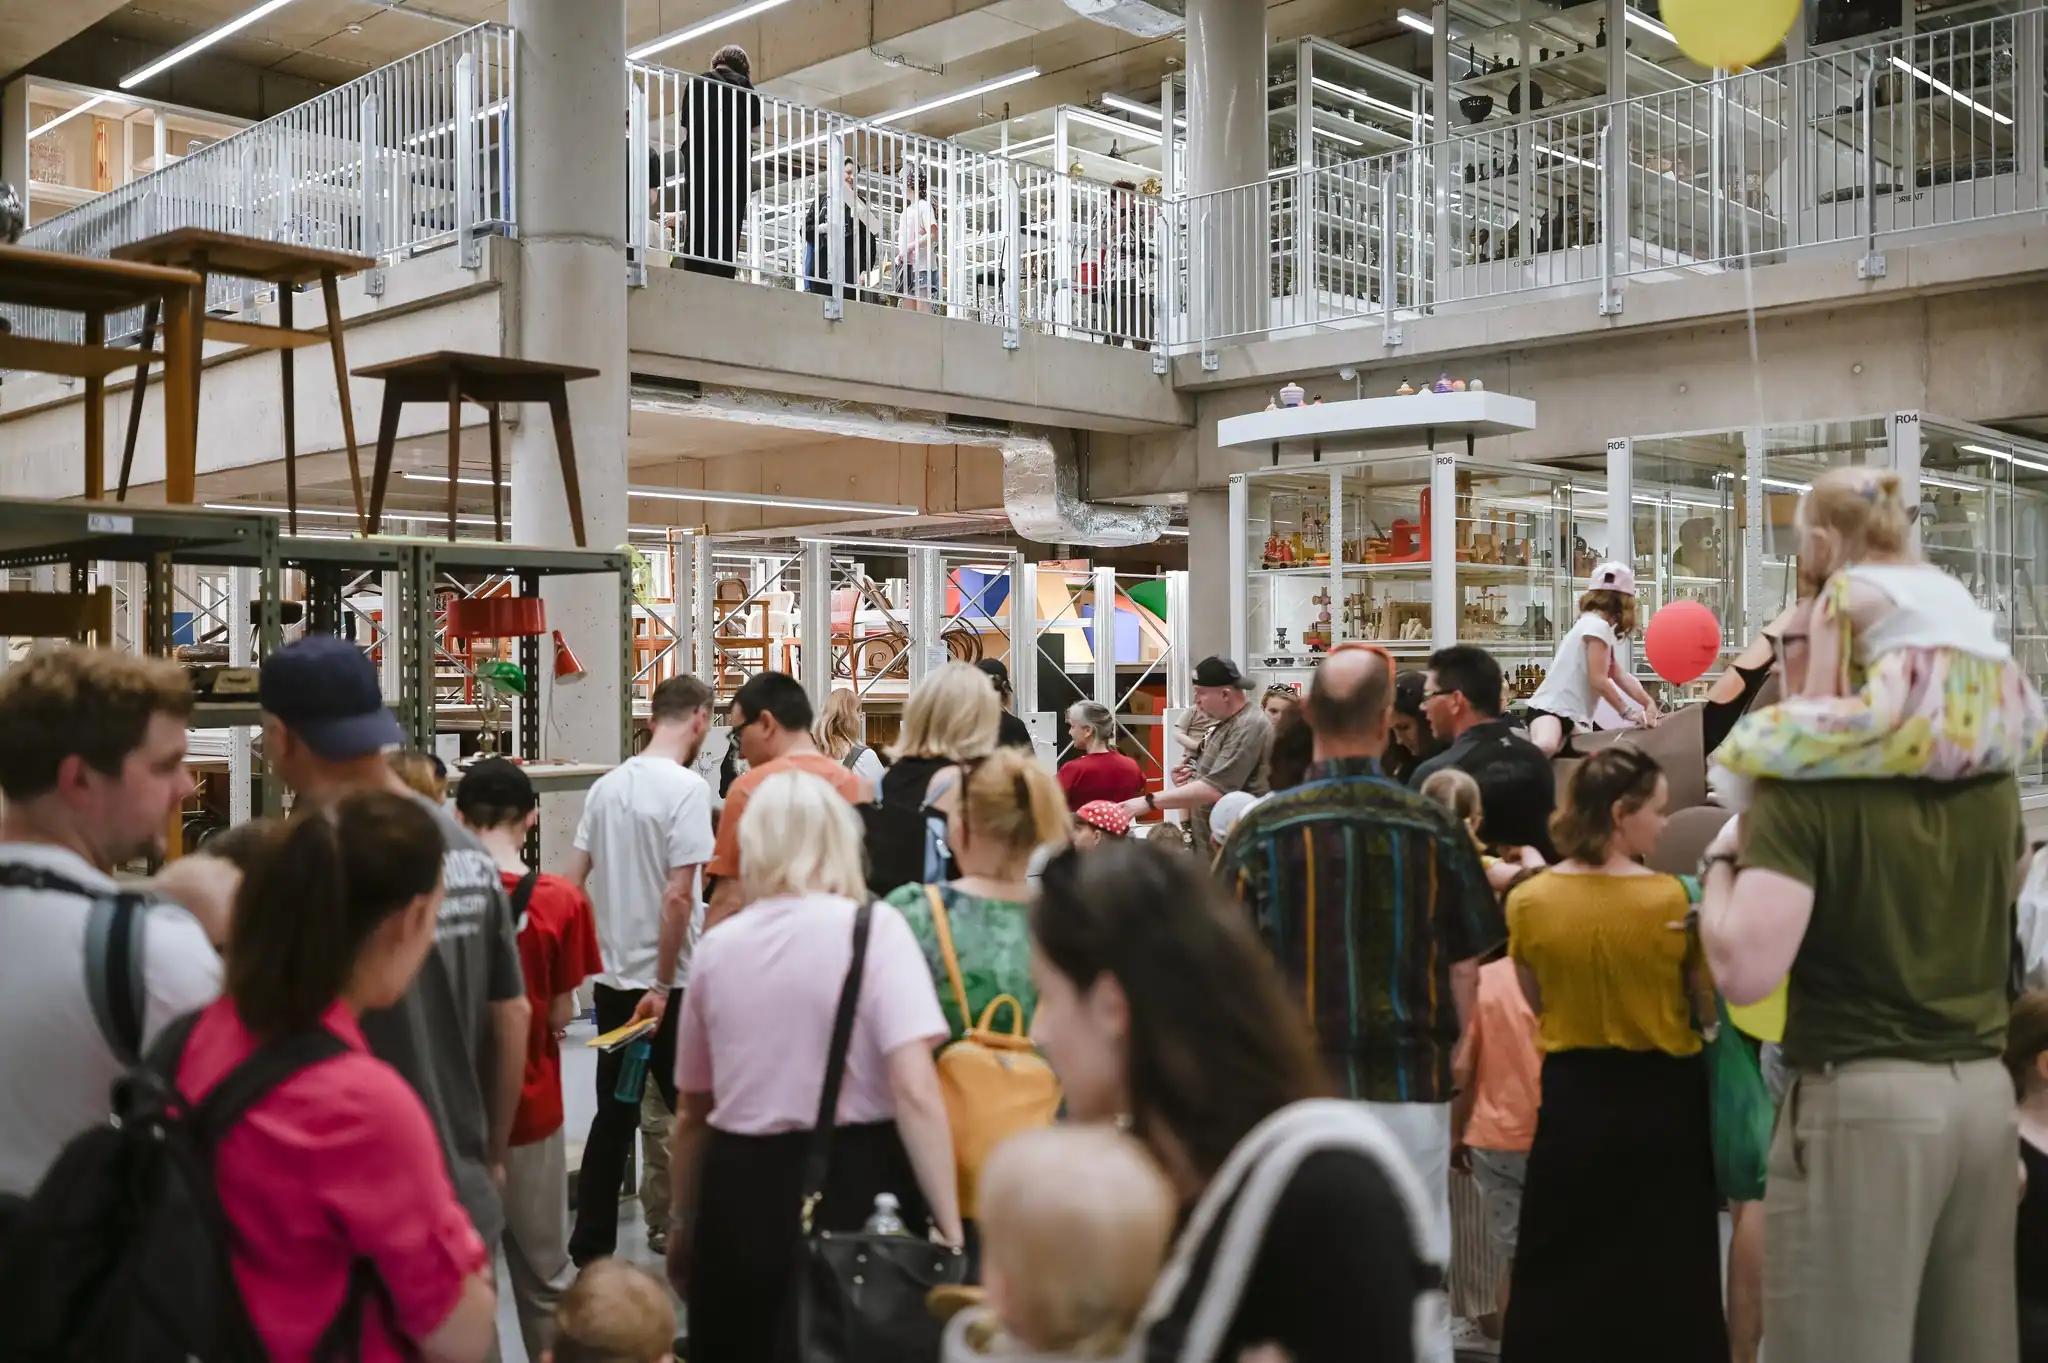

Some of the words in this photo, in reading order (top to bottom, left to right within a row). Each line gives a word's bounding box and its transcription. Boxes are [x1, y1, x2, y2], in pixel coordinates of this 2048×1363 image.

[1896, 414, 1919, 424] R04
[1607, 440, 1625, 450] R05
[1436, 456, 1453, 465] R06
[1229, 475, 1243, 484] R07
